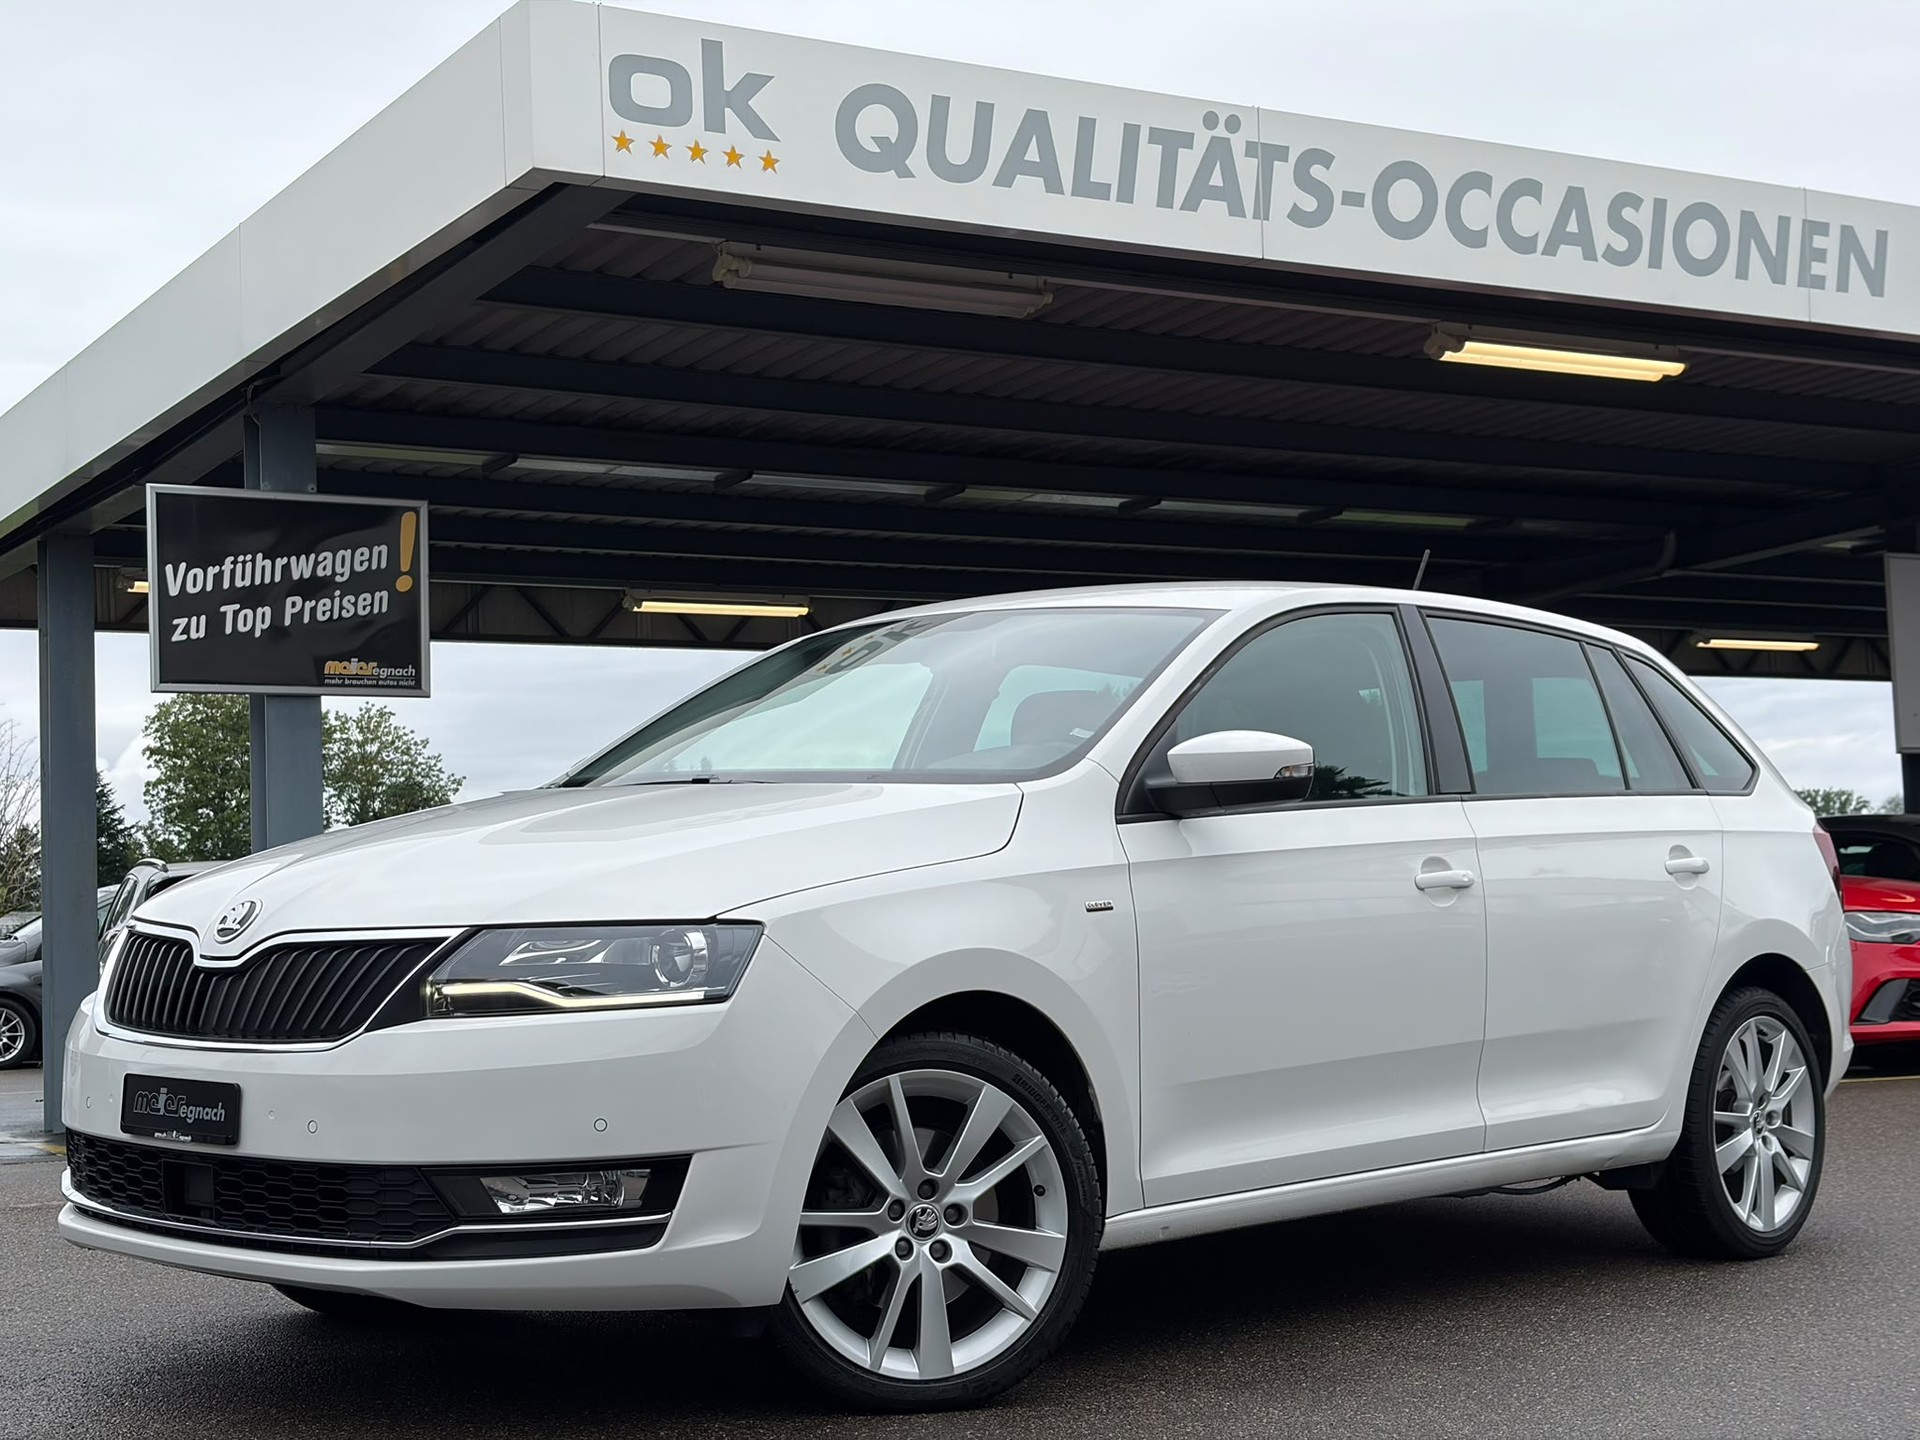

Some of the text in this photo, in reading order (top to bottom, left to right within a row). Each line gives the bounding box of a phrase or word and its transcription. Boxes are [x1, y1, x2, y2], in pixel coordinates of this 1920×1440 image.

[608, 38, 781, 142] ok
[834, 83, 1888, 298] QUALITÄTS-OCCASIONEN
[165, 544, 388, 597] Vorführwagen
[171, 589, 389, 642] zu Top Preisen
